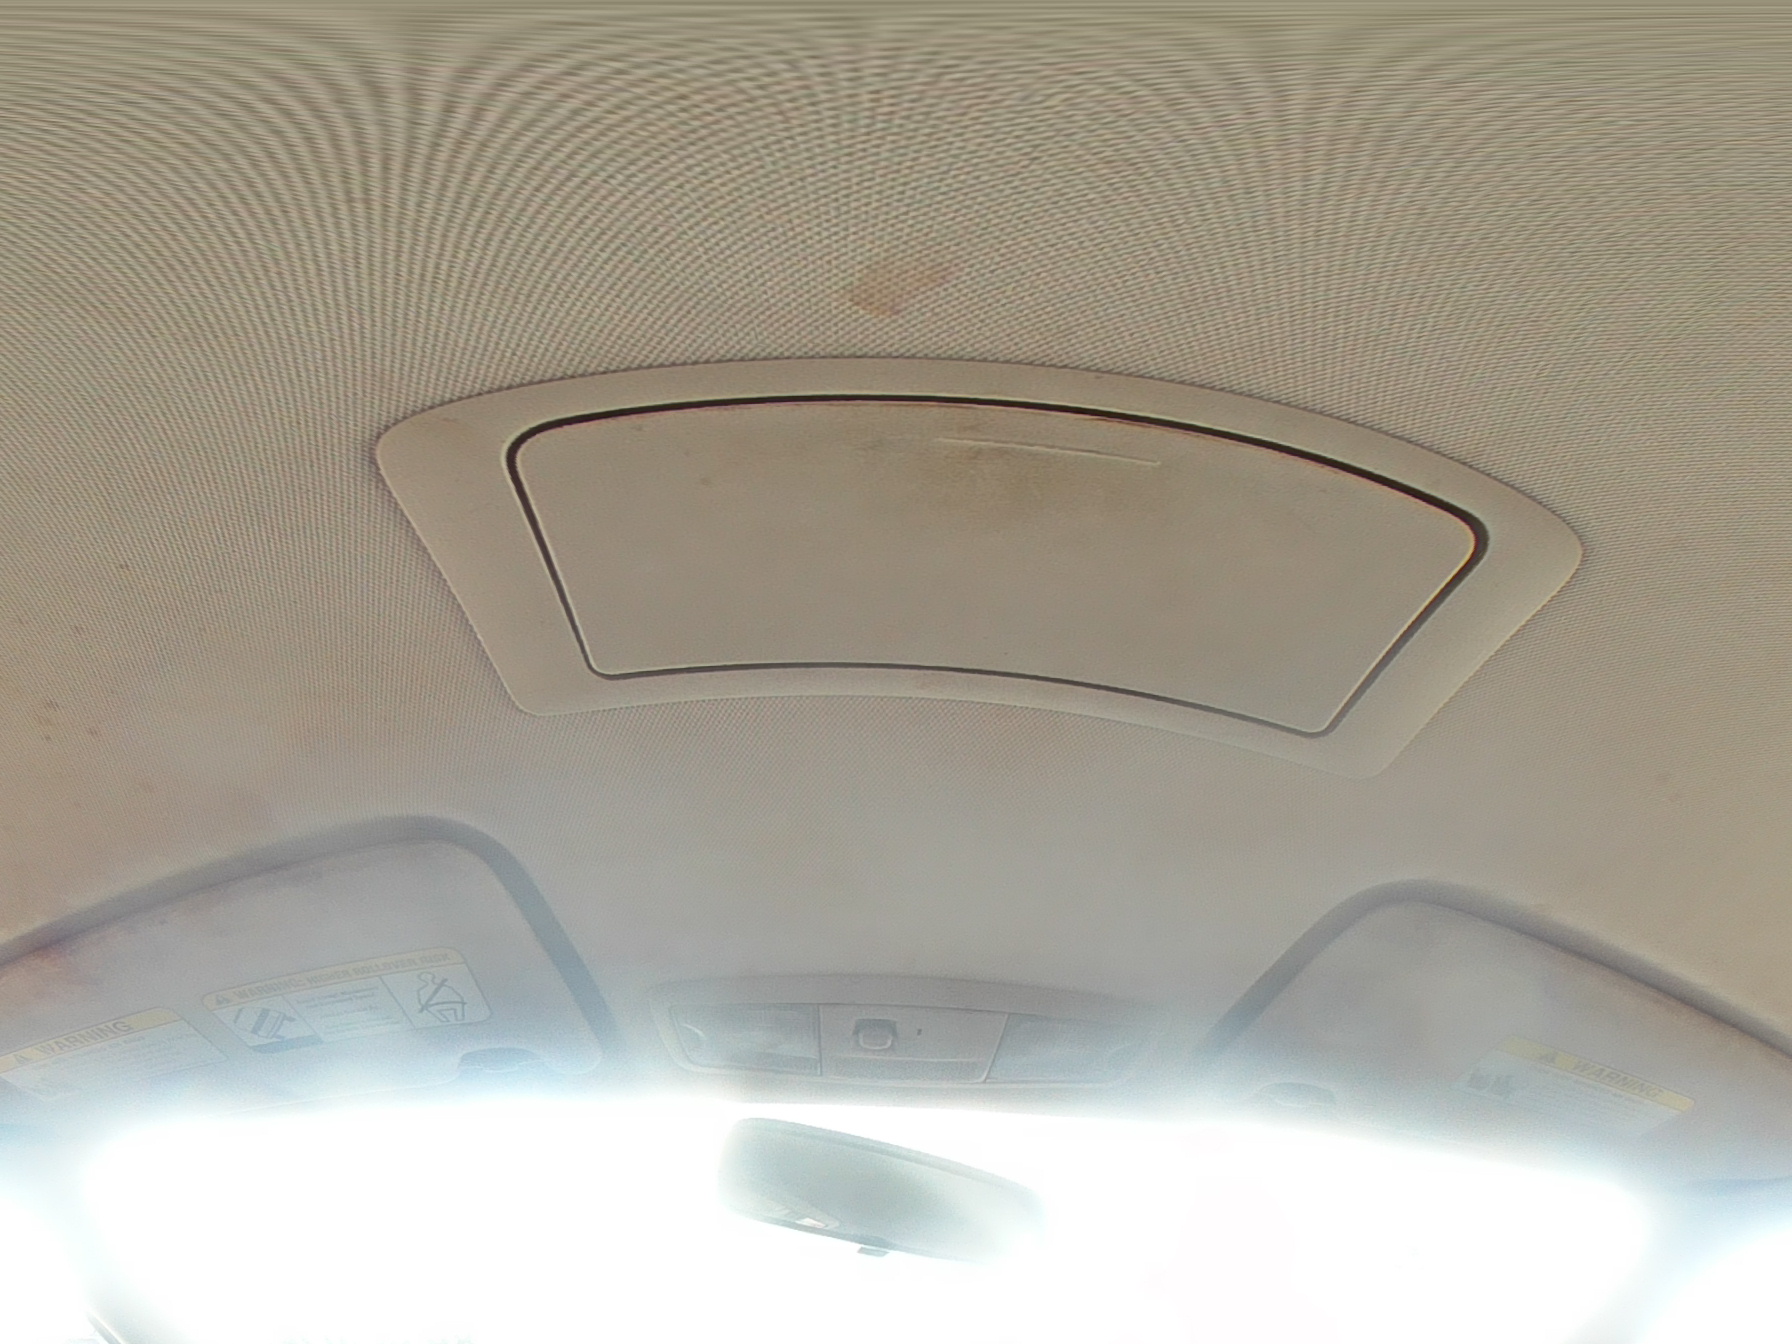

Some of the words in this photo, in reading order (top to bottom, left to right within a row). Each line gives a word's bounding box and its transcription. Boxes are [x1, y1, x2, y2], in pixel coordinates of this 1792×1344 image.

[352, 958, 419, 980] ROLLOVER
[420, 951, 451, 966] RISK
[34, 1020, 133, 1056] WARNING
[1572, 1059, 1664, 1099] WARNING
